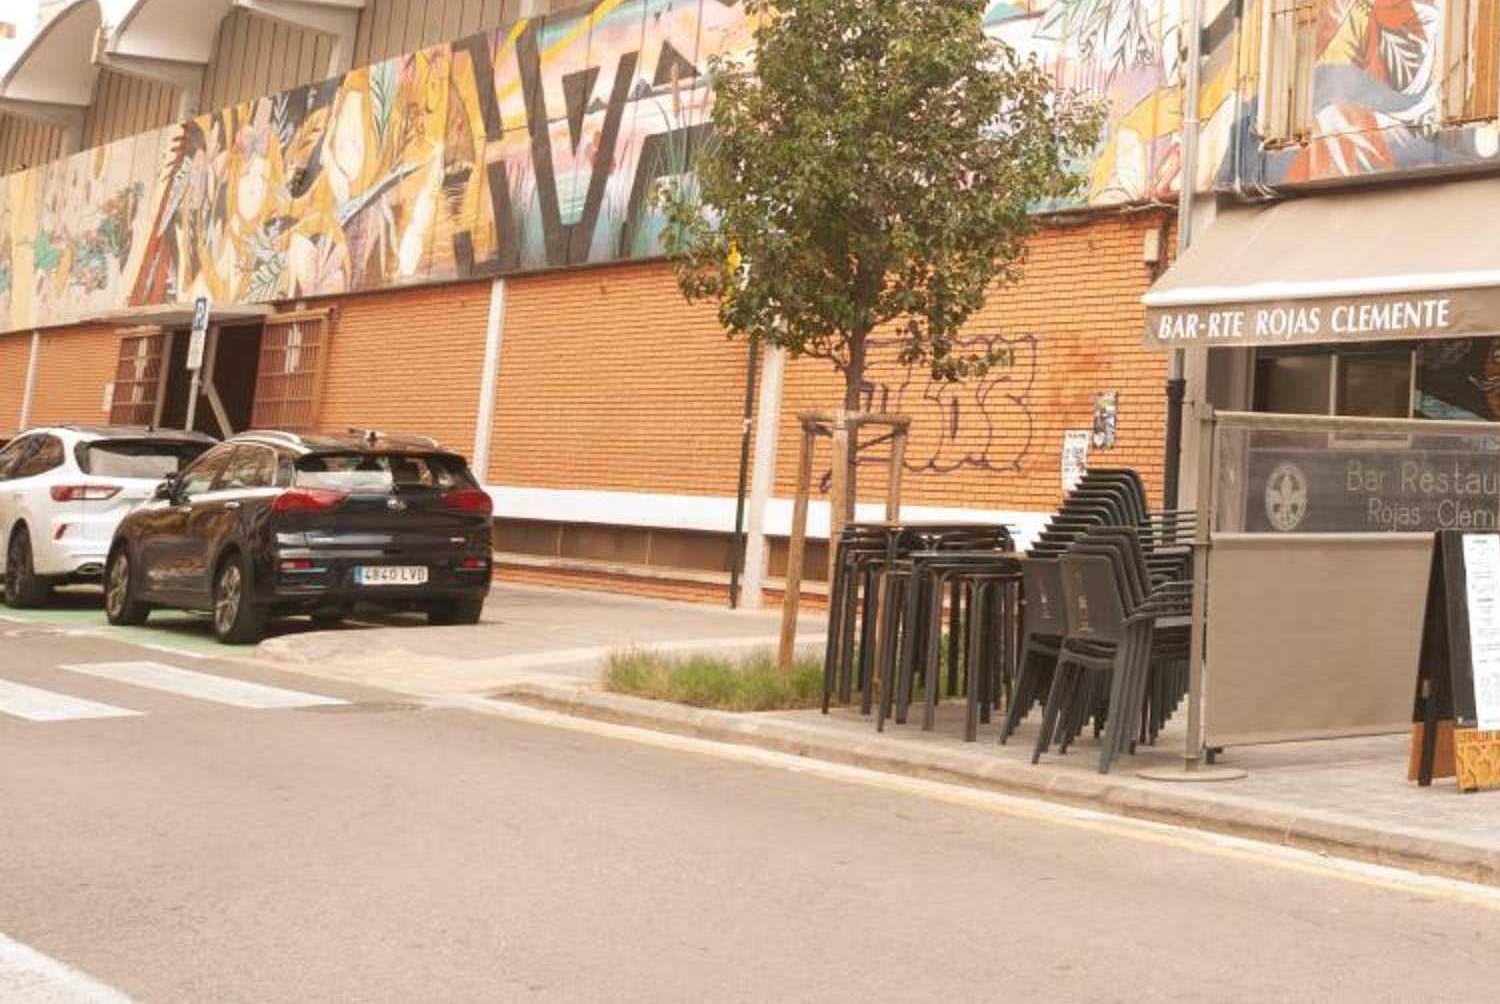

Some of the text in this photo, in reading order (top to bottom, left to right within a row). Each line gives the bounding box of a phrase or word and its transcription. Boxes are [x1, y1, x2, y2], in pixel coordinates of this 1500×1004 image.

[1157, 299, 1451, 340] BAR-RTE ROJAS CLEMENTE
[1346, 459, 1386, 492] Bar
[1367, 496, 1422, 532] Rojas
